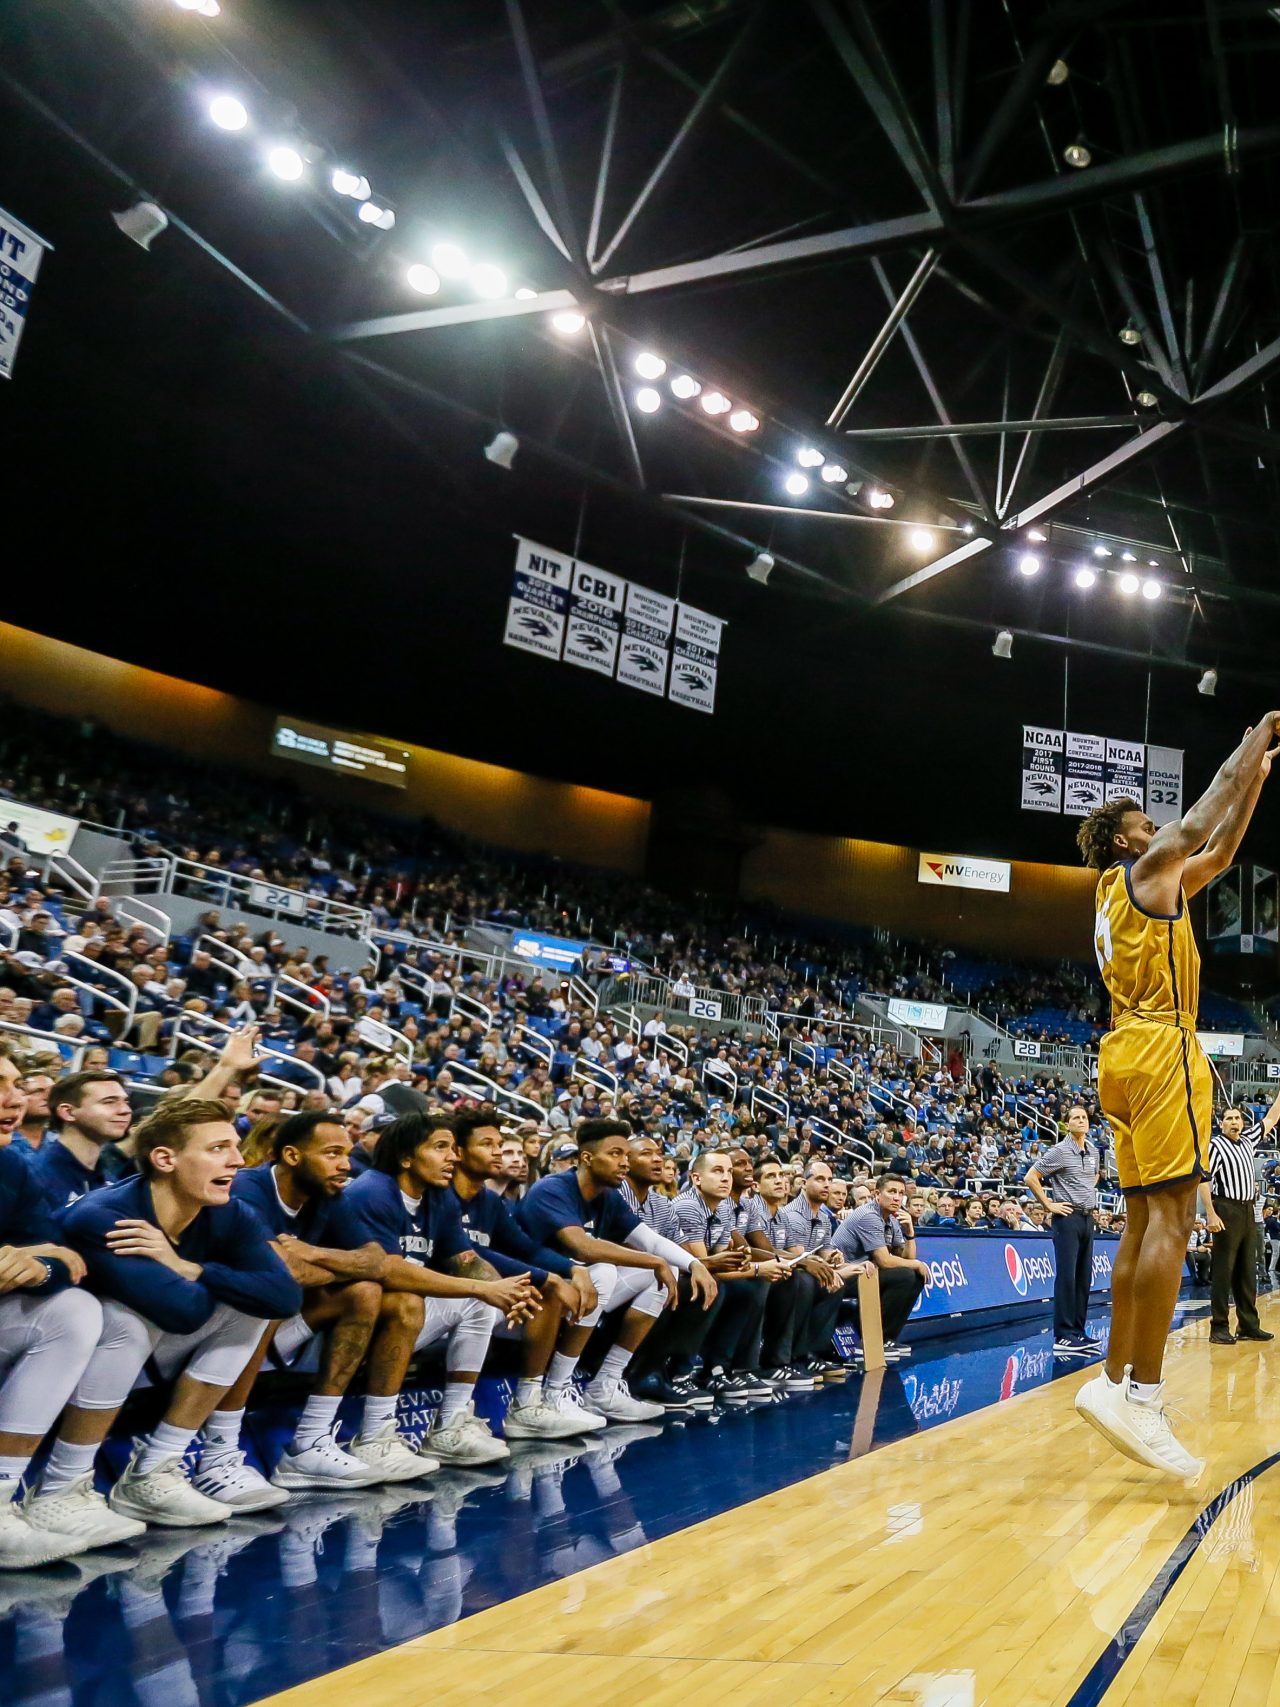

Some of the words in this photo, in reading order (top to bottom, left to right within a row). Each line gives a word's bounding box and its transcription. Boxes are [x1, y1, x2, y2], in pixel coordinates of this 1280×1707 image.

[528, 553, 561, 578] NIT
[578, 573, 616, 602] CBI
[577, 596, 613, 618] 2016
[513, 607, 559, 631] NEVADA
[571, 623, 613, 645] NEVADA
[623, 643, 664, 665] NEVADA
[686, 643, 707, 656] 2017
[674, 663, 712, 685] NEVADA
[1025, 731, 1062, 747] NCAA
[1072, 737, 1099, 745] MOUNTAIN
[1034, 749, 1052, 758] 2017
[1068, 750, 1103, 760] CONFERENCE
[1109, 747, 1142, 762] NCAA
[1030, 763, 1055, 773] ROUND
[1032, 757, 1053, 765] FIRST
[1068, 761, 1102, 771] 2017-2018
[1068, 768, 1102, 777] CHAMPIONS
[1149, 771, 1180, 780] EDGAR
[1025, 773, 1058, 787] NEVADA
[1112, 779, 1137, 787] SIXTEEN
[1149, 779, 1179, 788] JONES
[1067, 781, 1102, 795] NEVADA
[1108, 787, 1140, 800] NEVADA
[1023, 799, 1059, 808] BASKETBALL
[1150, 789, 1178, 806] 32
[266, 890, 290, 908] 24
[694, 1002, 716, 1018] 26
[924, 1007, 943, 1018] FLY
[1018, 1042, 1037, 1056] 28
[1023, 1252, 1054, 1285] pepsi
[1091, 1251, 1113, 1277] pepsi
[925, 1254, 968, 1297] pepsi
